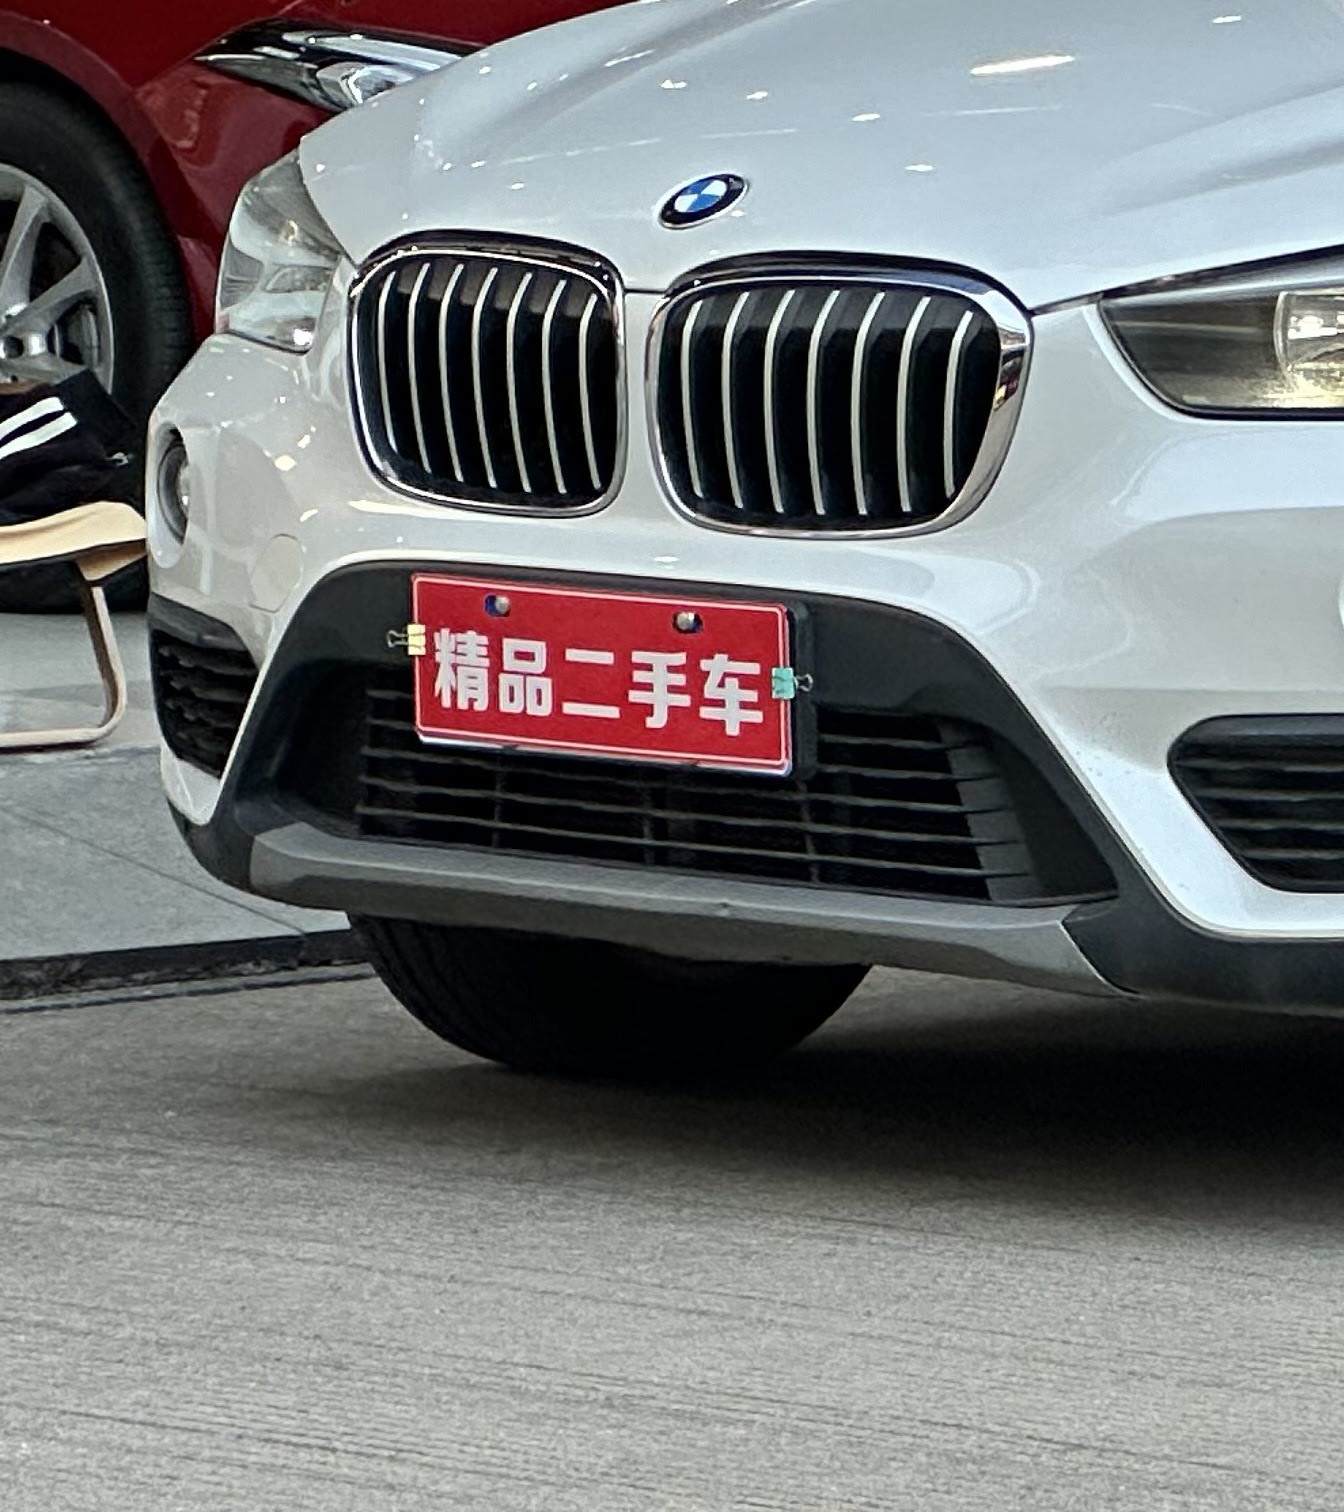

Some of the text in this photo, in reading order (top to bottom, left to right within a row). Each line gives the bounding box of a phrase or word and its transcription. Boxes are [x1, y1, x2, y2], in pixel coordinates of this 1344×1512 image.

[433, 627, 765, 738] 精品二手车
